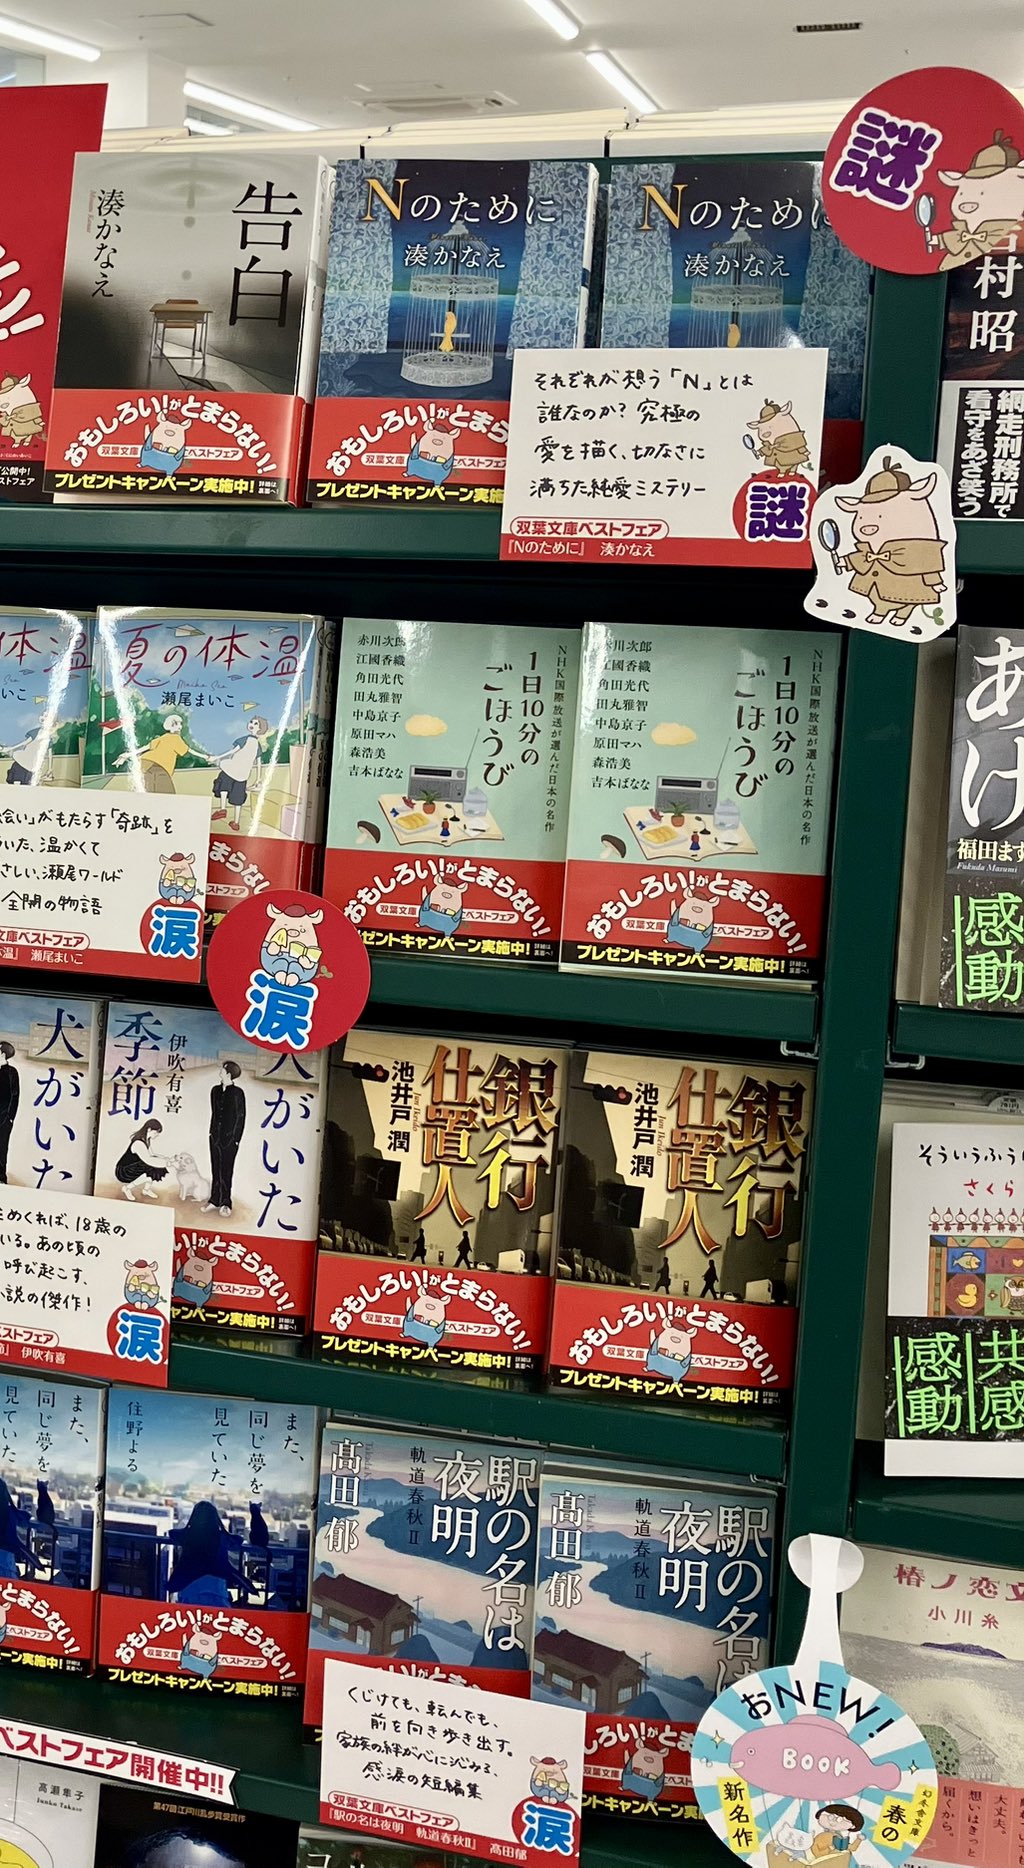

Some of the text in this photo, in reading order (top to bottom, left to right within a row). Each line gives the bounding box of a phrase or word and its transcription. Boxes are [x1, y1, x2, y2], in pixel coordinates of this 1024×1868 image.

[834, 110, 939, 207] 謎
[362, 178, 556, 224] Nのために
[93, 188, 124, 298] 湊かなえ
[229, 182, 302, 328] 告白
[101, 446, 139, 456] 双葉文庫
[957, 390, 993, 516] 看守をあざ笑う
[529, 476, 707, 499] 満ちた純愛ミステリー
[516, 521, 663, 537] 双葉文庫ベストフェア
[354, 691, 403, 704] 田丸雅智
[355, 672, 404, 685] 角田光代
[353, 709, 401, 723] 中島京子
[482, 663, 515, 787] ごほうび
[519, 651, 544, 766] 1日10分の
[350, 747, 386, 760] 森浩美
[351, 728, 397, 740] 原田マハ
[348, 765, 404, 779] 吉本ばなな
[957, 862, 1018, 873] Fukuda Masumi
[3, 891, 103, 916] 全開の物語
[625, 919, 666, 930] 双葉文庫
[388, 1061, 414, 1152] 池井戸潤
[413, 1044, 485, 1227] 仕置人
[477, 1051, 558, 1213] 銀行
[919, 1143, 1024, 1166] そういうふう
[964, 1178, 1015, 1198] さくら
[115, 1312, 164, 1362] 涙
[905, 1331, 963, 1435] 感動
[1, 1385, 20, 1462] 見ていた
[36, 1389, 56, 1473] 同じ夢を
[431, 1449, 483, 1560] 夜明
[481, 1454, 538, 1653] 駅の名は
[928, 1606, 999, 1629] 小川糸
[362, 1760, 483, 1800] 感涙の短編集
[782, 1747, 851, 1777] BOOK
[522, 1803, 574, 1854] 涙
[723, 1781, 753, 1847] 新名作
[882, 1805, 907, 1841] 春の
[968, 1790, 982, 1857] 想いはきっと
